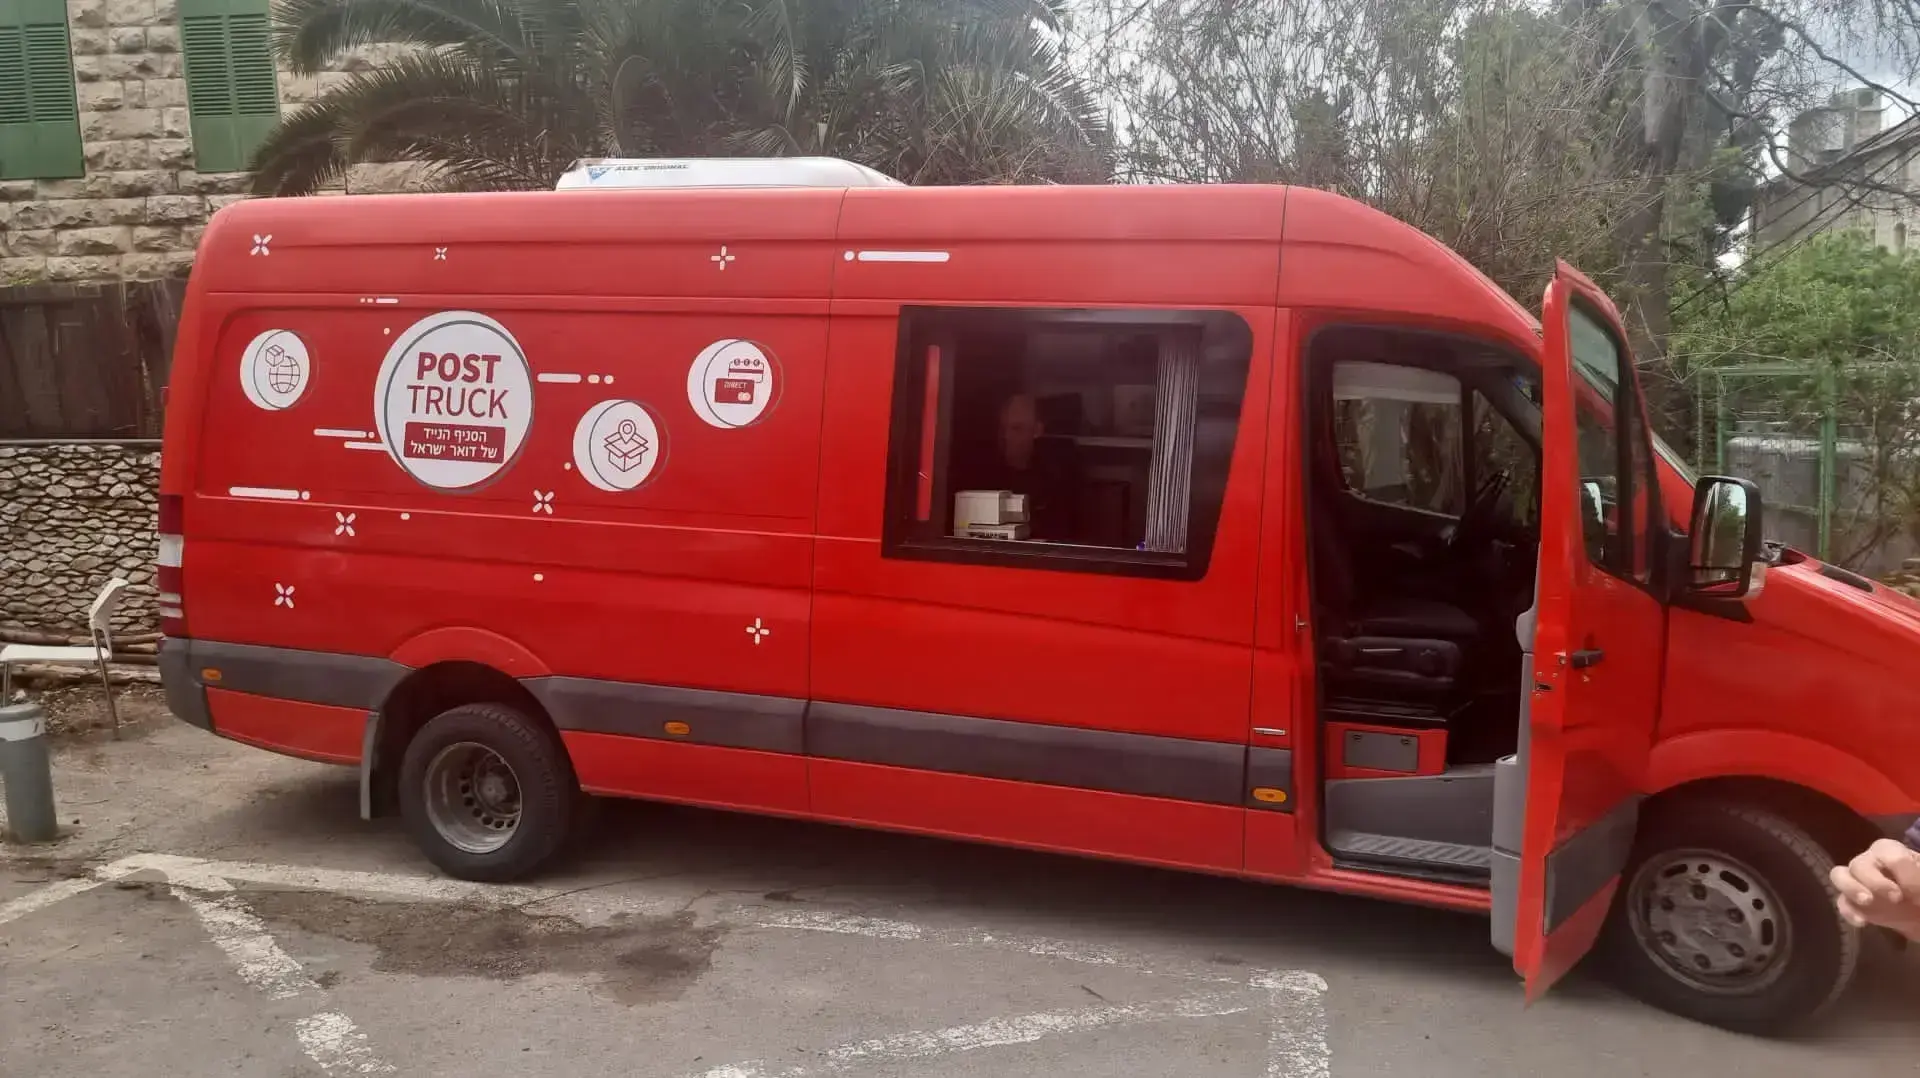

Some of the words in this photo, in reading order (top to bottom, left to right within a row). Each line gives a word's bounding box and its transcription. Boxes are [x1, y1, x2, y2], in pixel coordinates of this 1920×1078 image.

[417, 352, 501, 383] POST
[407, 385, 509, 419] TRUCK
[424, 427, 450, 440] הנייד
[454, 430, 487, 443] הסניף
[410, 440, 446, 455] ישראל
[449, 445, 477, 457] דואר
[480, 444, 498, 459] של
